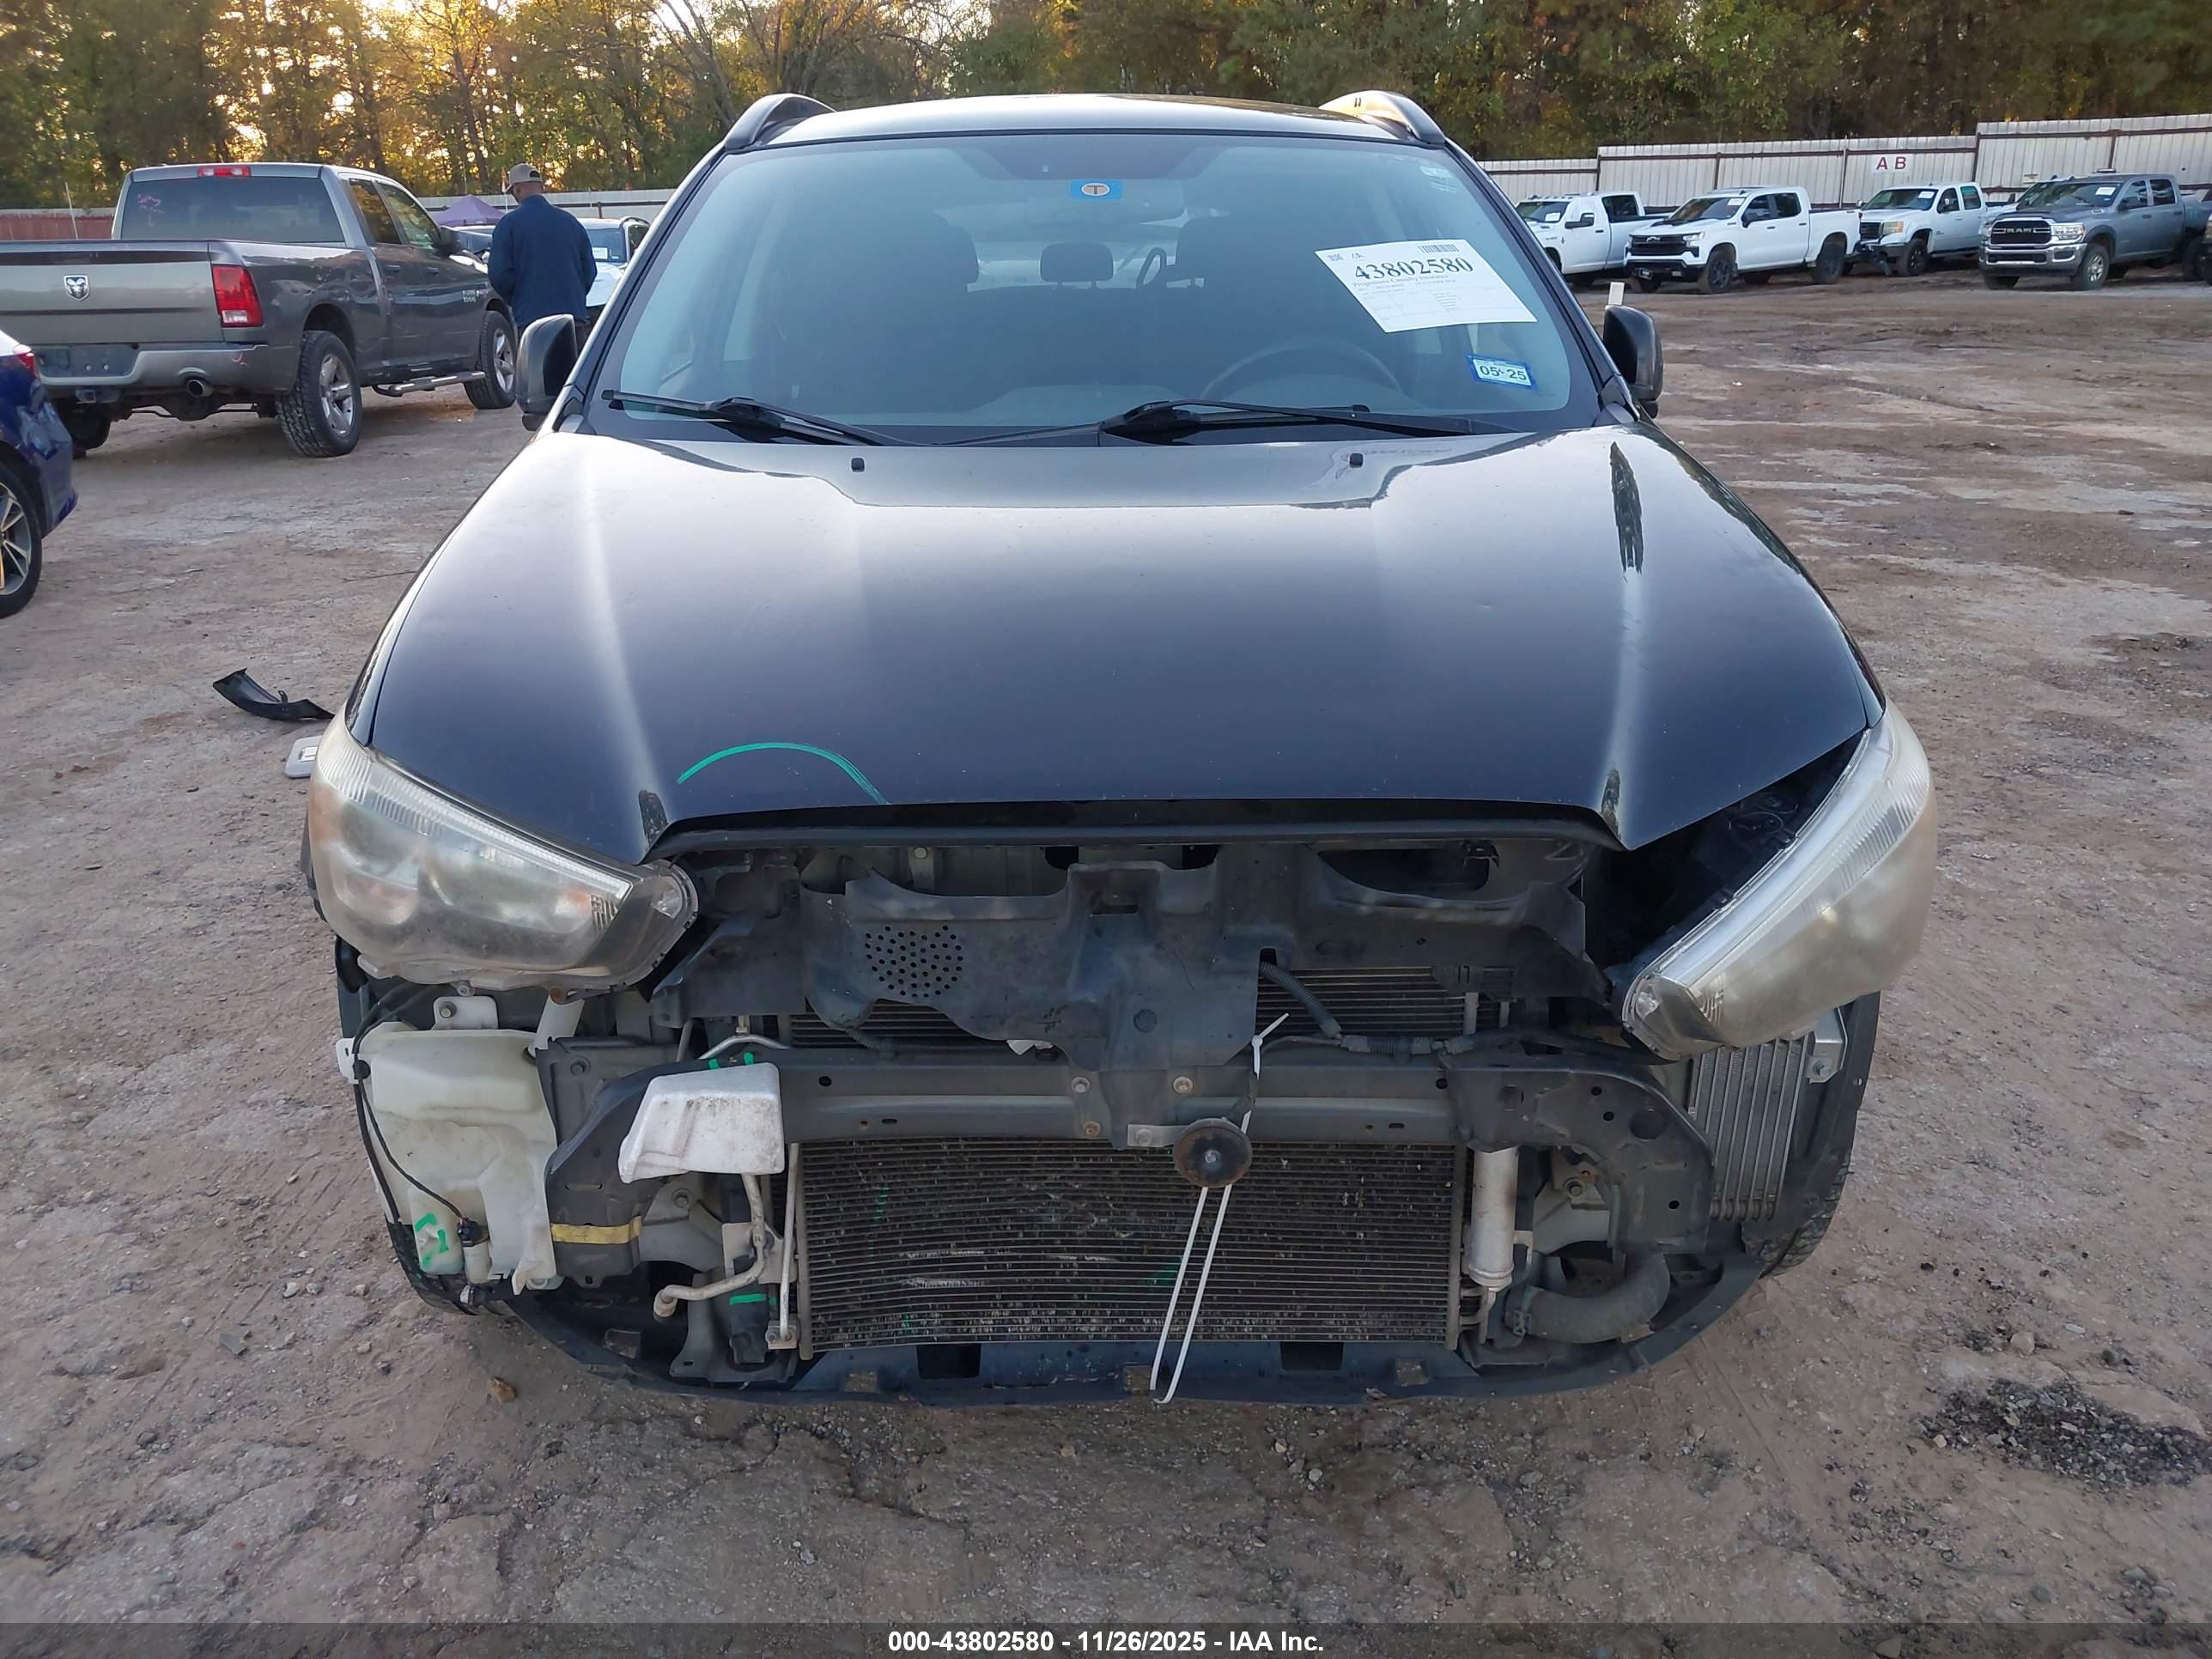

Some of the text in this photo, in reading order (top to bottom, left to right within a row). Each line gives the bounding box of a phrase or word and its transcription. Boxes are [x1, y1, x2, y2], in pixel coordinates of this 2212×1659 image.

[1875, 156, 1906, 170] A B
[1354, 257, 1474, 280] 43802580
[1480, 365, 1527, 380] 05 25
